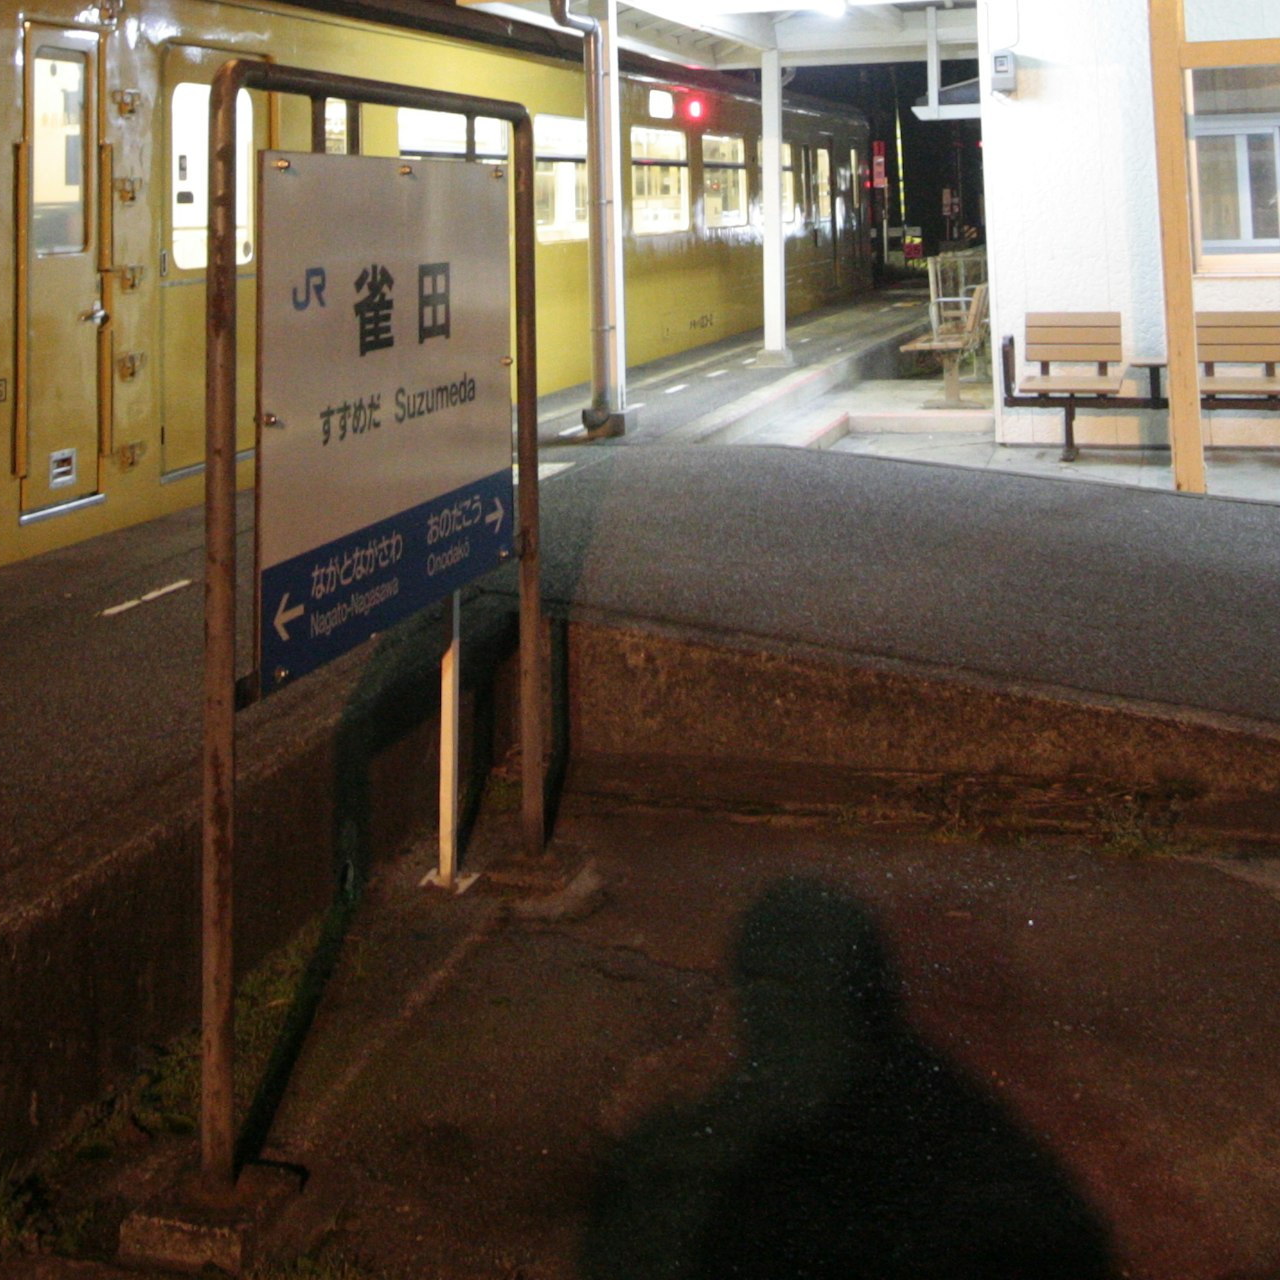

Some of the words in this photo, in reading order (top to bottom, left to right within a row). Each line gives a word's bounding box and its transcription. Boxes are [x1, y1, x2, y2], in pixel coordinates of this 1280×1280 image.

[292, 266, 327, 311] JR
[353, 261, 451, 357] 雀田
[320, 392, 382, 446] すずめだ
[394, 372, 476, 424] Suzumeda
[426, 494, 483, 545] おのだこう
[310, 529, 404, 600] ながとながさわ
[309, 576, 400, 639] Nagato-Nagasawa
